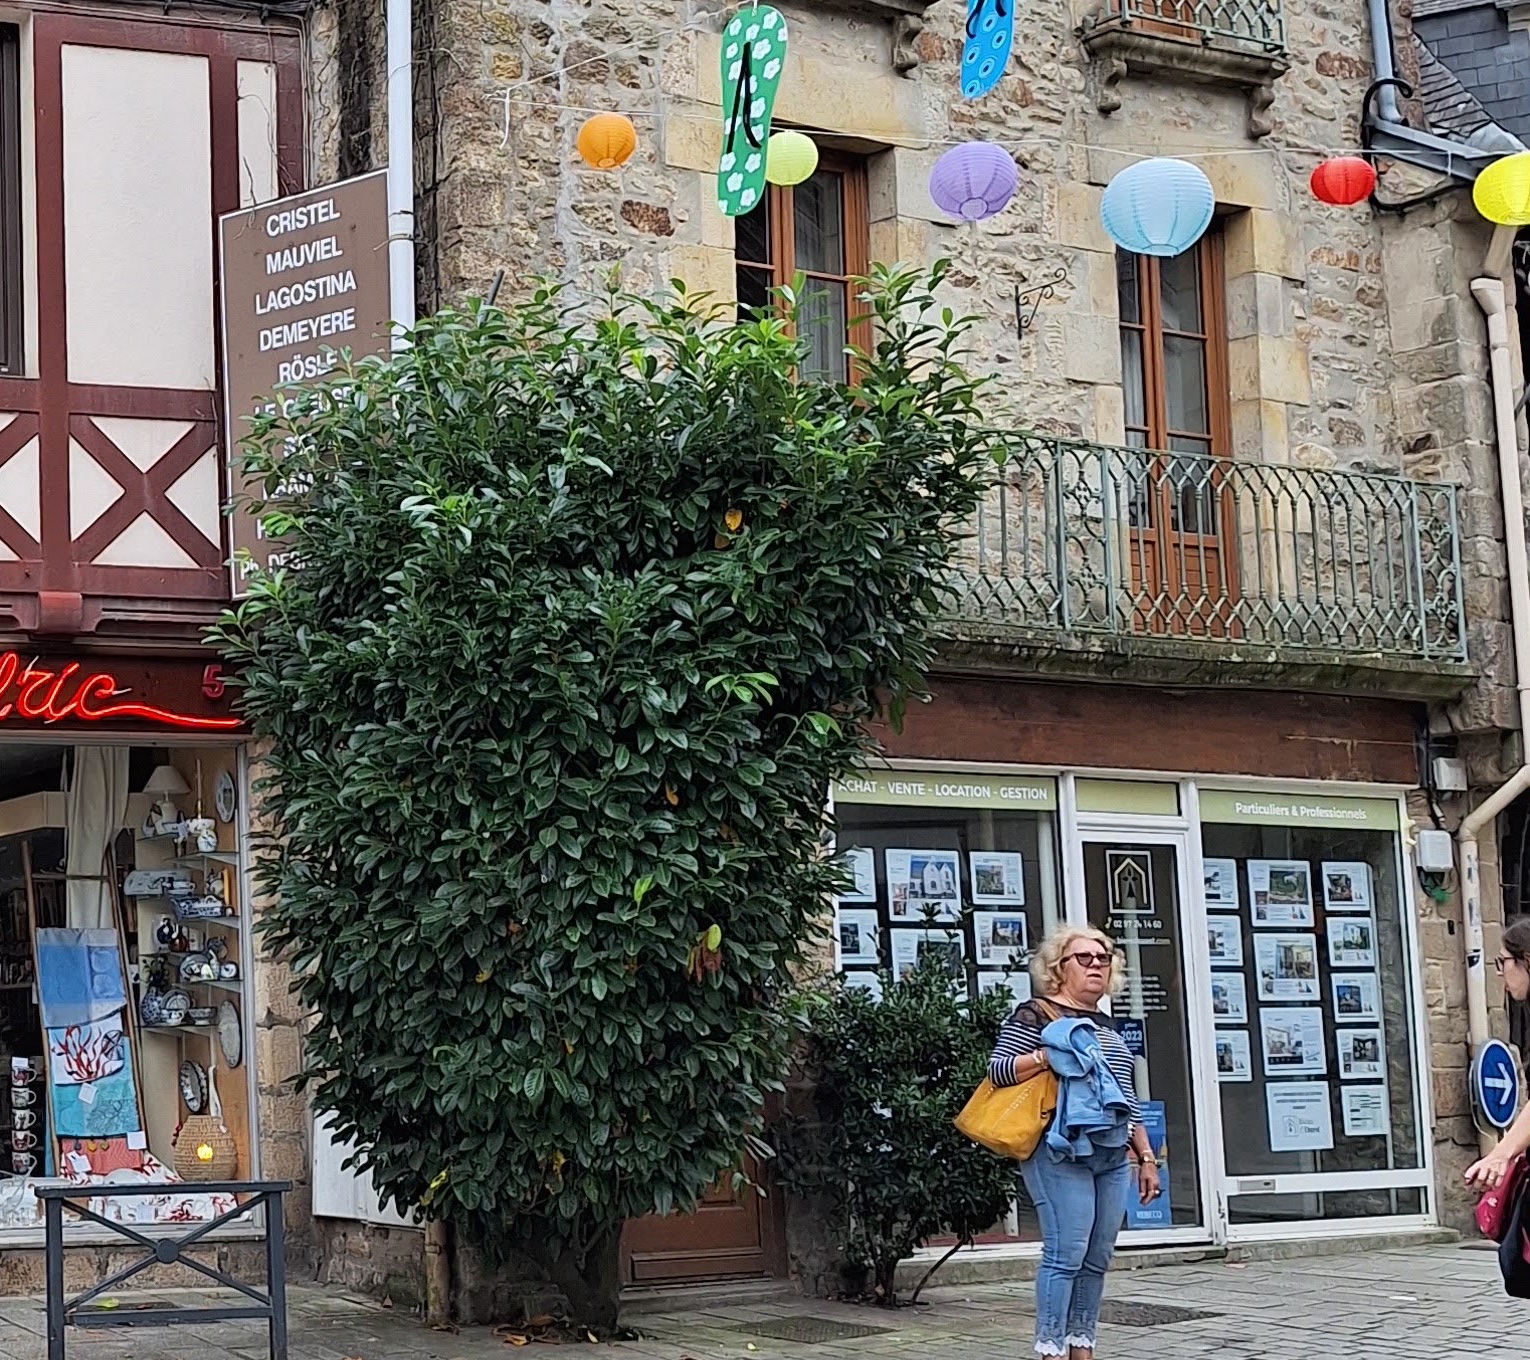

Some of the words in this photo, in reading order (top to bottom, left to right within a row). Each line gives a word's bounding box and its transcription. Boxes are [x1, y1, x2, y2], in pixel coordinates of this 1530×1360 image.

[266, 198, 341, 237] CRISTEL
[265, 235, 344, 275] MAUVIEL
[254, 270, 357, 315] LAGOSTINA
[259, 307, 356, 352] DEMEYERE
[201, 665, 224, 698] 5
[887, 781, 926, 796] VENTE
[935, 783, 991, 798] LOCATION
[999, 786, 1048, 800] GESTION
[1235, 802, 1289, 816] Particuliers
[1291, 805, 1299, 816] &
[1300, 806, 1367, 820] Professionnels
